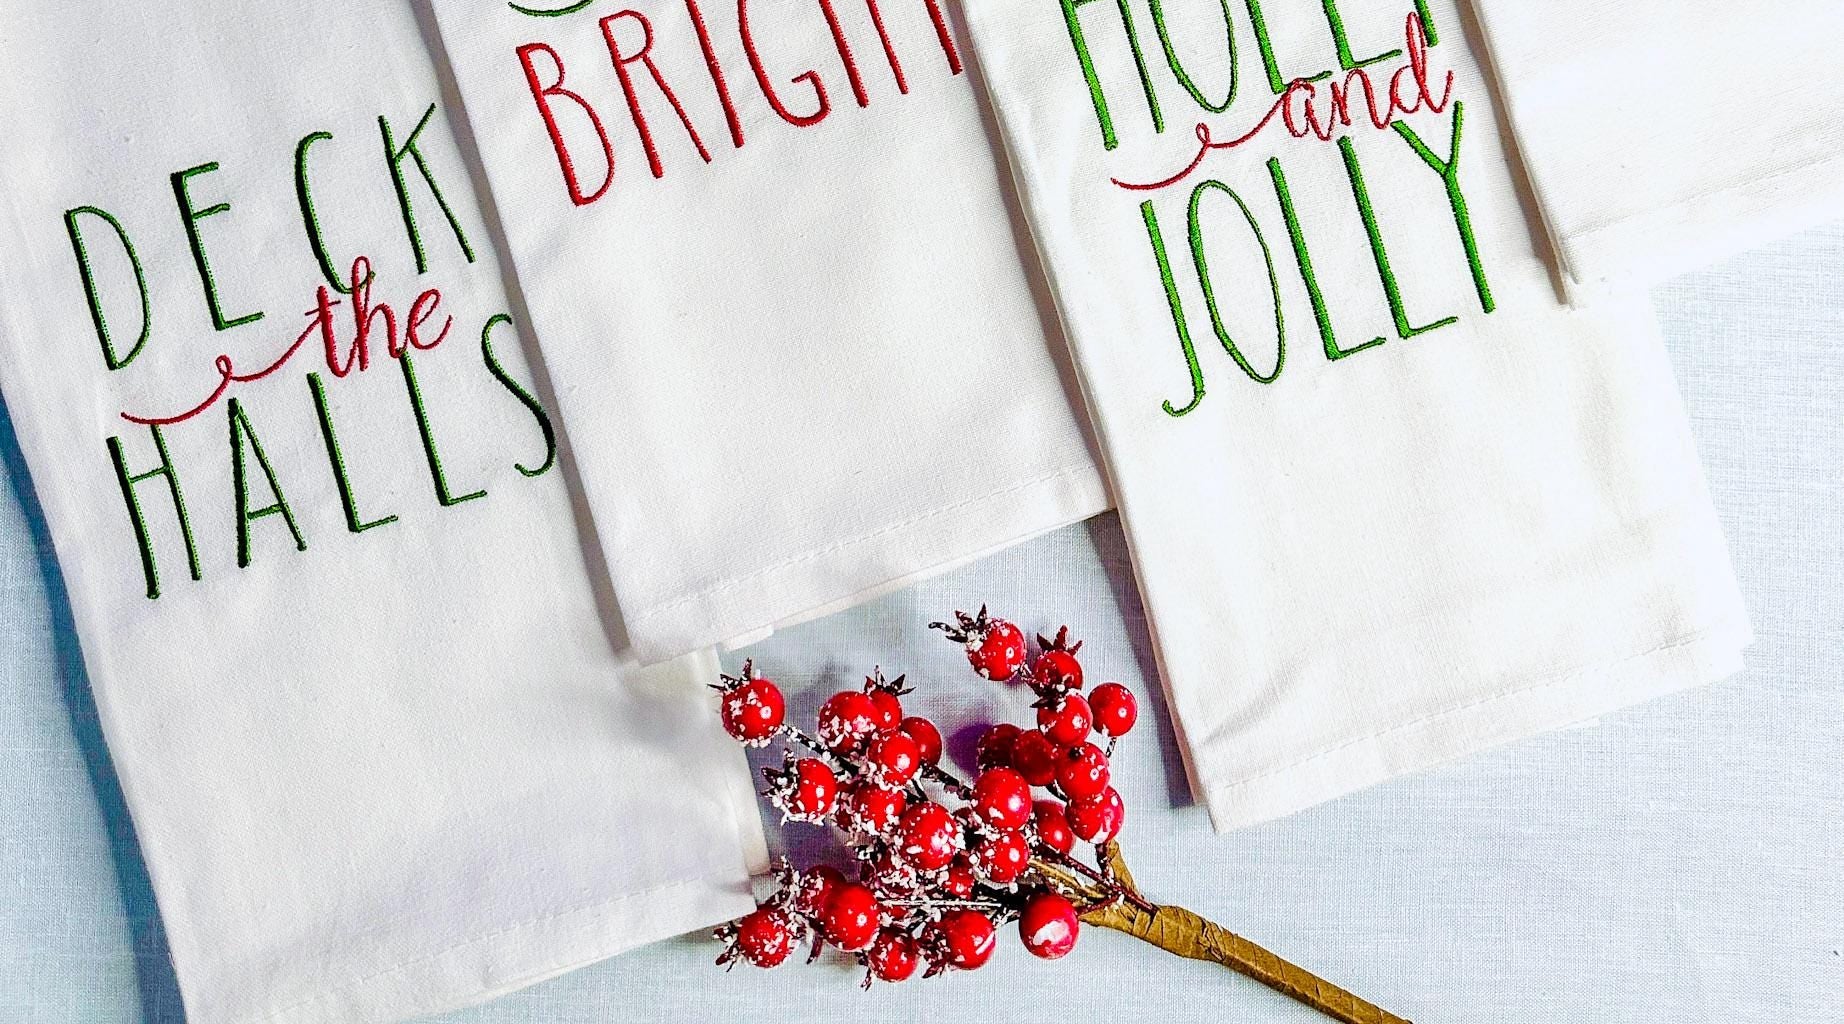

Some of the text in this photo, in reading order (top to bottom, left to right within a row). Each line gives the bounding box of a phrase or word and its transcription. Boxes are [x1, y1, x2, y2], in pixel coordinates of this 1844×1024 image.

[64, 103, 476, 371] DECK
[1140, 100, 1496, 417] JOLLY
[107, 313, 557, 600] HALLS
